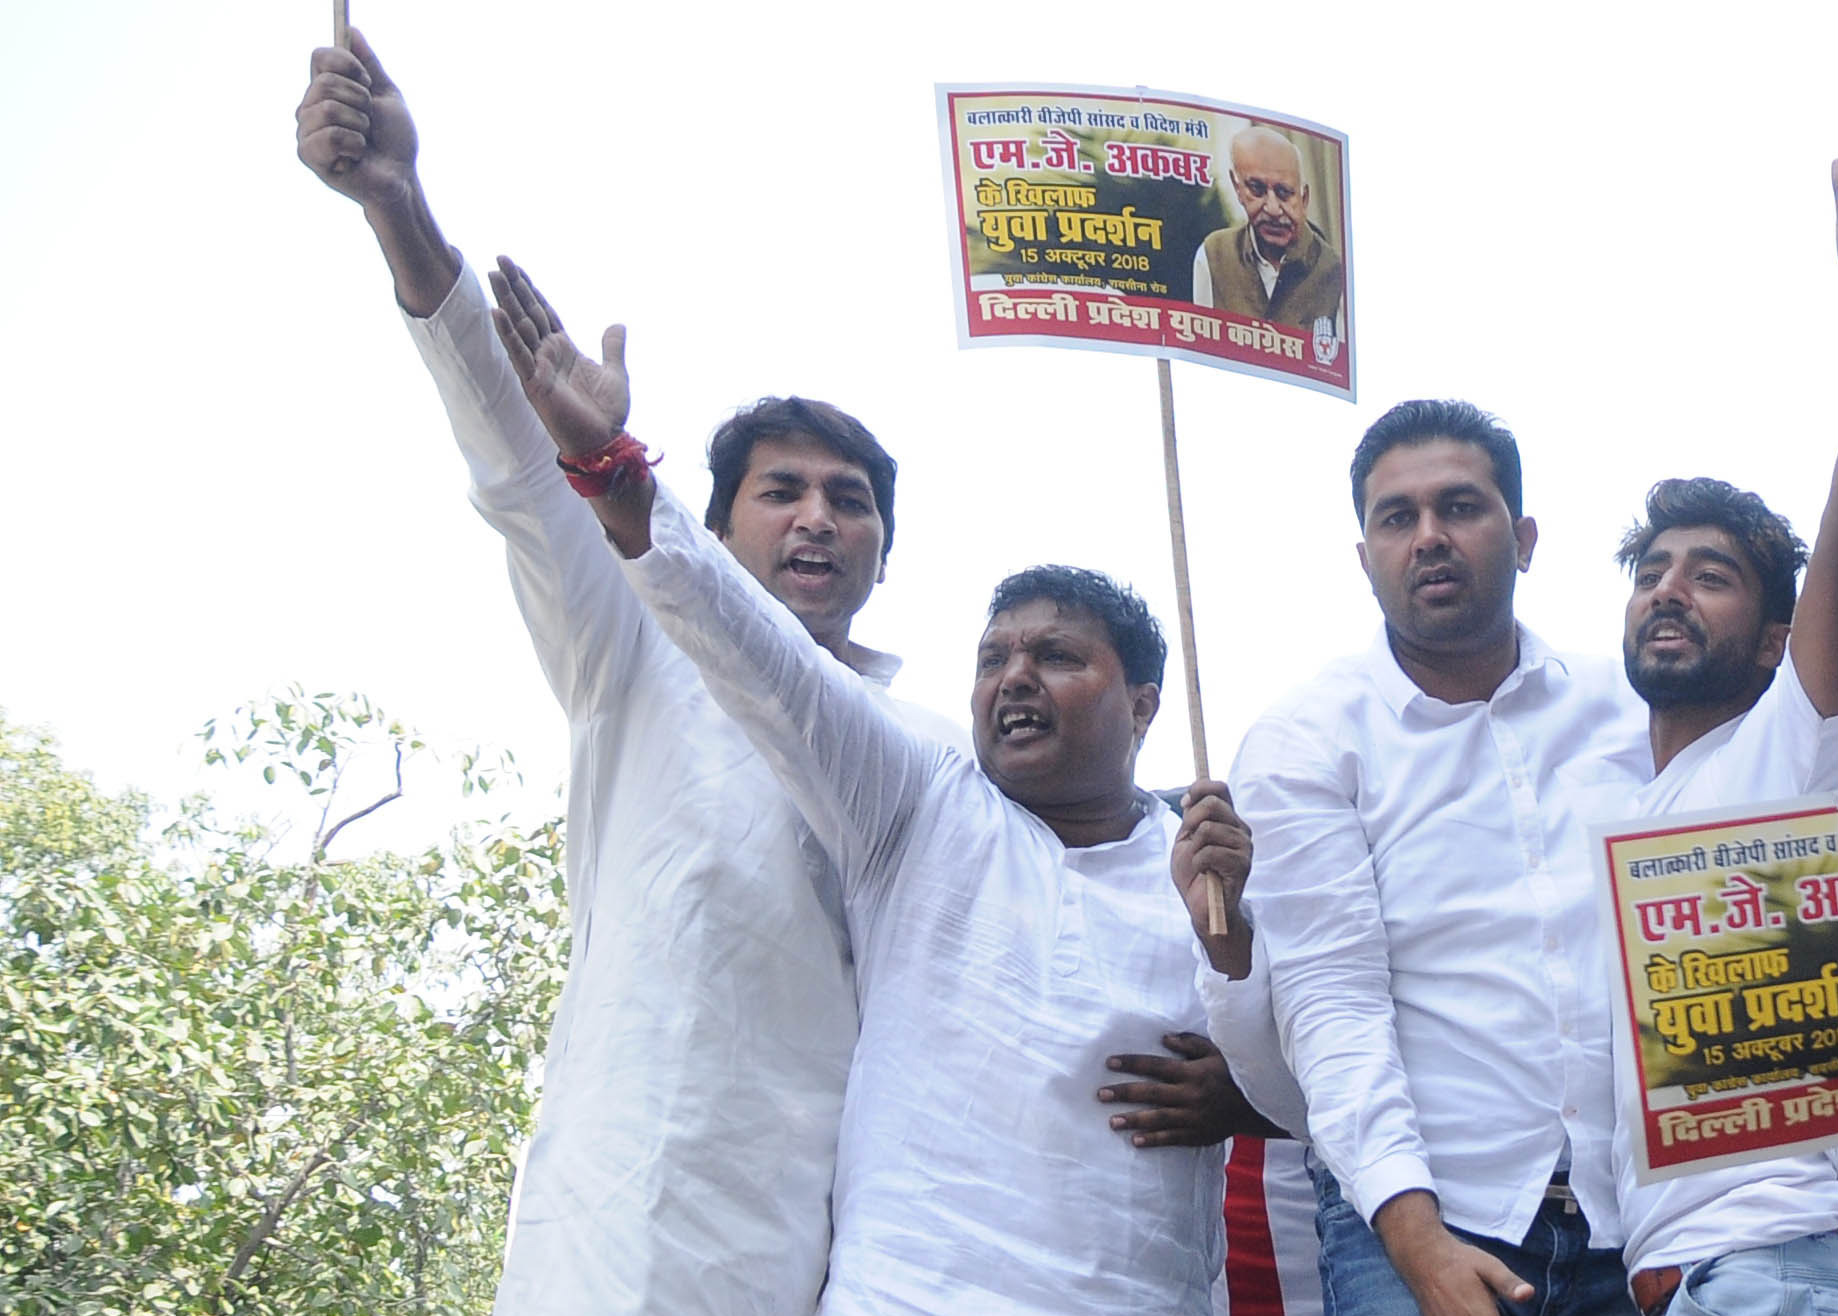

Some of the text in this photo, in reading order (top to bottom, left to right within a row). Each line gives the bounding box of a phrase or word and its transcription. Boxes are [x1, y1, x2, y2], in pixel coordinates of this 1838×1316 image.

[1087, 109, 1125, 129] सांसद
[1130, 115, 1140, 130] व
[1144, 113, 1180, 134] विदेश
[1184, 118, 1208, 139] मंत्री
[970, 131, 1212, 184] एम.जे. अकबर
[975, 180, 1097, 208] के खिलाफ
[979, 206, 1163, 252] युवा प्रदर्शन
[1021, 248, 1150, 271] 15 अक्टूबर 2018
[979, 293, 1304, 361] दिल्ली प्रदेश युवा कांग्रेस
[1628, 847, 1706, 880] बलात्कारी
[1713, 839, 1767, 869] बीजेपी
[1773, 834, 1818, 861] सांसद
[1826, 834, 1836, 853] व
[1636, 875, 1783, 941] एम.जे.
[1646, 949, 1789, 993] के खिलाफ
[1651, 992, 1734, 1056] युवा
[1703, 1045, 1725, 1065] 15
[1731, 1032, 1804, 1061] अक्टूबर
[1657, 1099, 1771, 1147] दिल्ली
